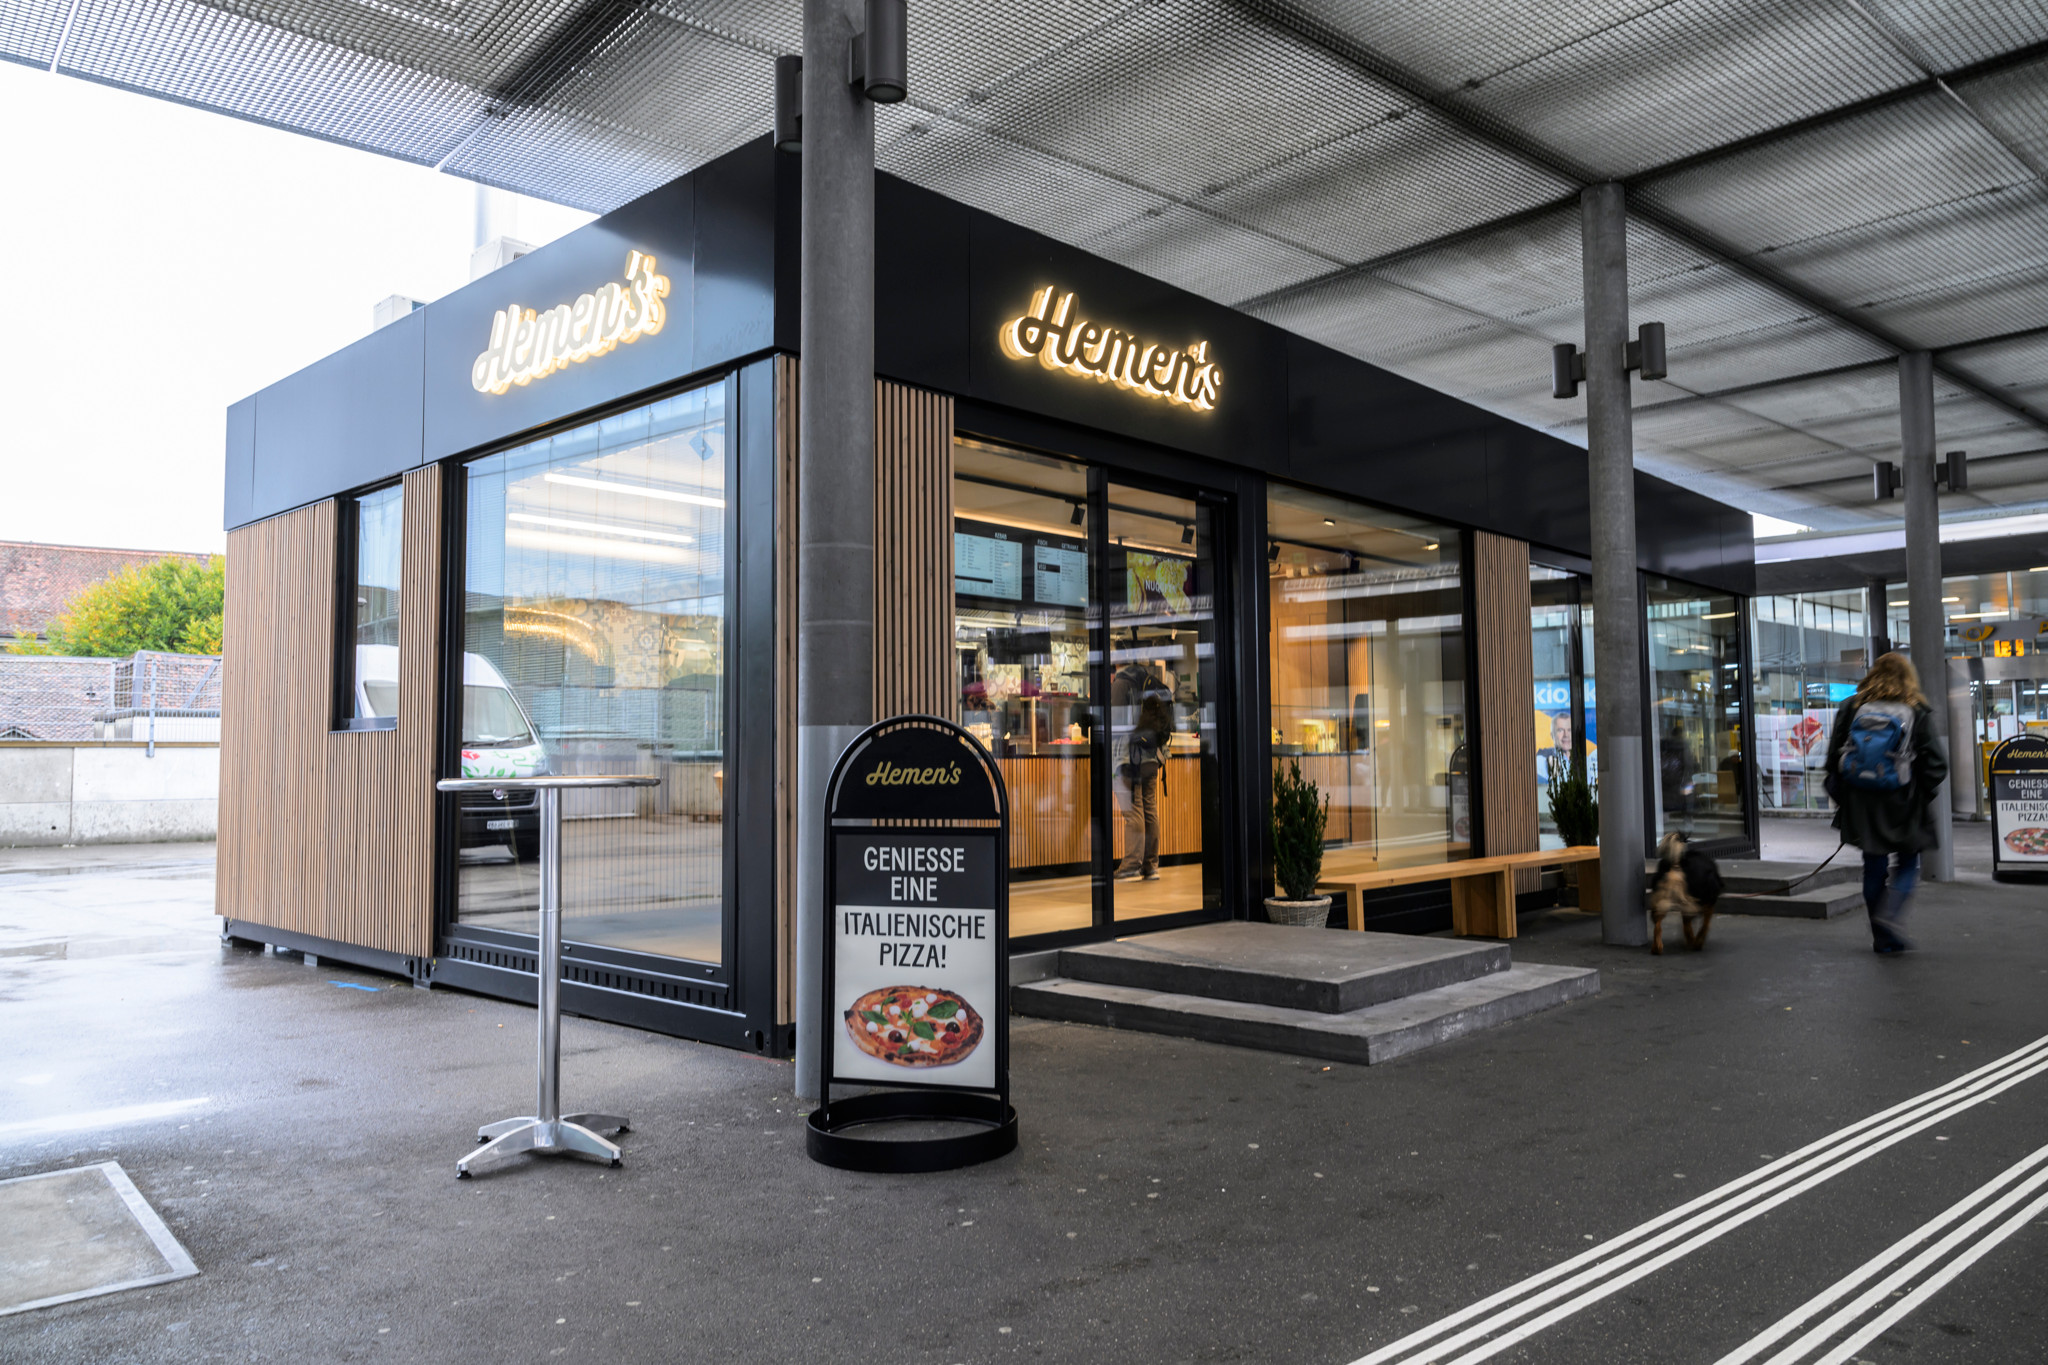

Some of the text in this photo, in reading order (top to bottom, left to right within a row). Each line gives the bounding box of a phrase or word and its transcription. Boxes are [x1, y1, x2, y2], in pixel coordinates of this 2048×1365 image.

[472, 250, 671, 394] Hemen's
[1000, 285, 1224, 412] Hemen's
[1534, 683, 1596, 706] kiok
[866, 760, 962, 786] Hemen's
[2021, 789, 2043, 800] EINE
[863, 846, 965, 873] GENIESSE
[890, 875, 938, 902] EINE
[844, 912, 986, 940] ITALIENISCHE
[879, 943, 947, 968] PIZZA!
